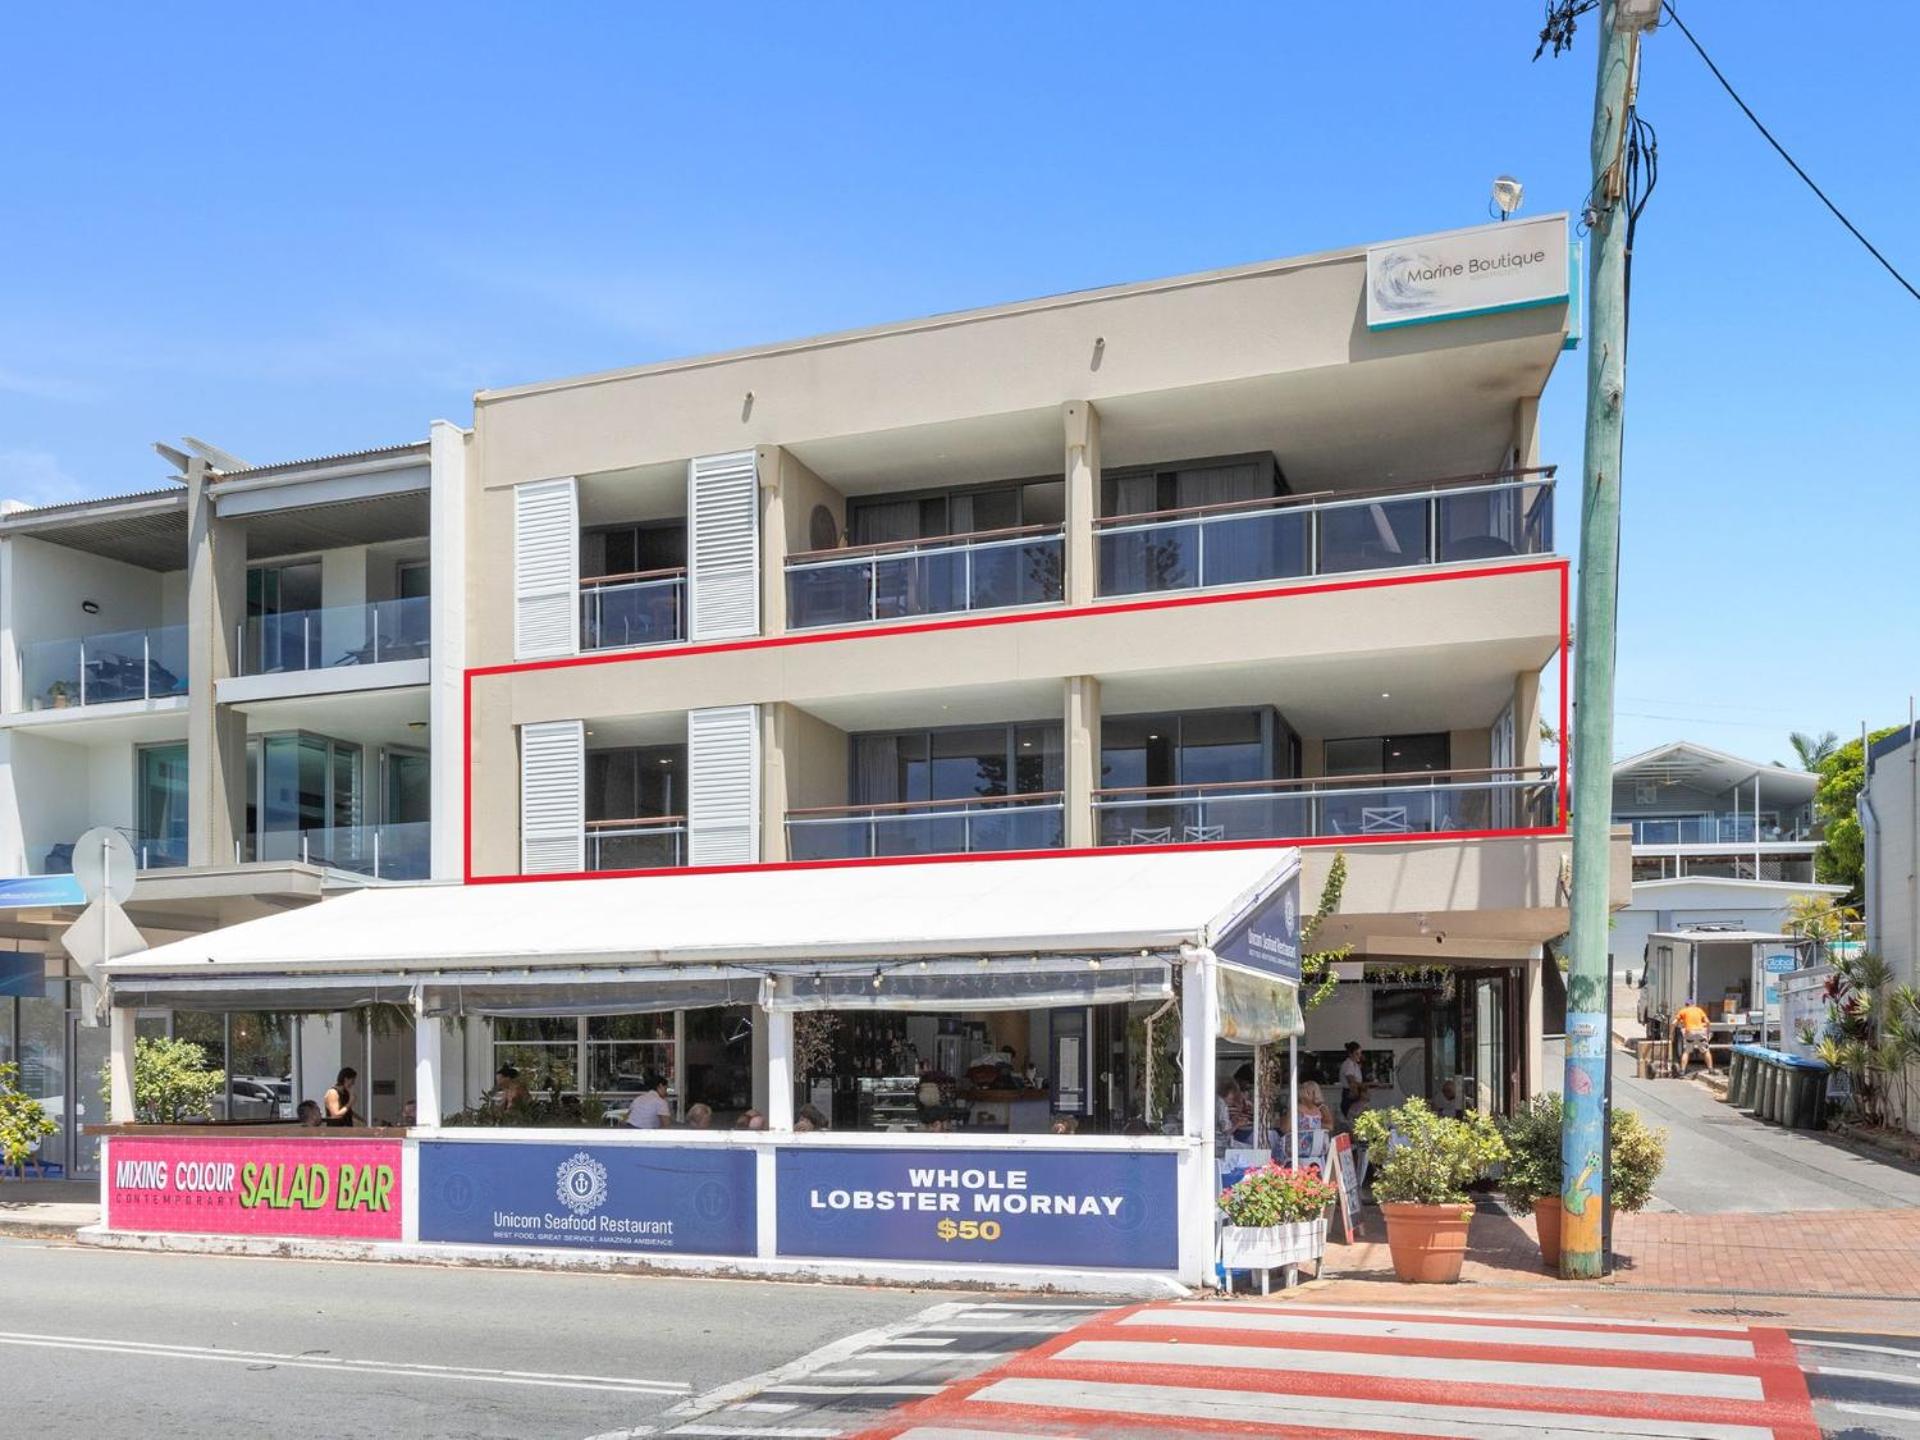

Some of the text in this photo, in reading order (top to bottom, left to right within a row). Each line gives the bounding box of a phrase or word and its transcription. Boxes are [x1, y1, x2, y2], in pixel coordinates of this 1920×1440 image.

[1407, 263, 1464, 284] Marine
[1468, 250, 1546, 274] Boutique
[116, 1160, 395, 1211] MIXING COLOUR SALAD BAR
[908, 1168, 1028, 1190] WHOLE
[115, 1192, 235, 1207] CONTEMPORARY
[810, 1190, 1123, 1215] LOBSTER MORNAY
[493, 1211, 674, 1235] Unicorn Seafood Restaurant
[936, 1217, 1001, 1242] $50
[493, 1231, 512, 1239] BEST
[538, 1233, 562, 1241] GREAT
[598, 1236, 632, 1244] AMAZING
[633, 1238, 674, 1247] AMBIENCE
